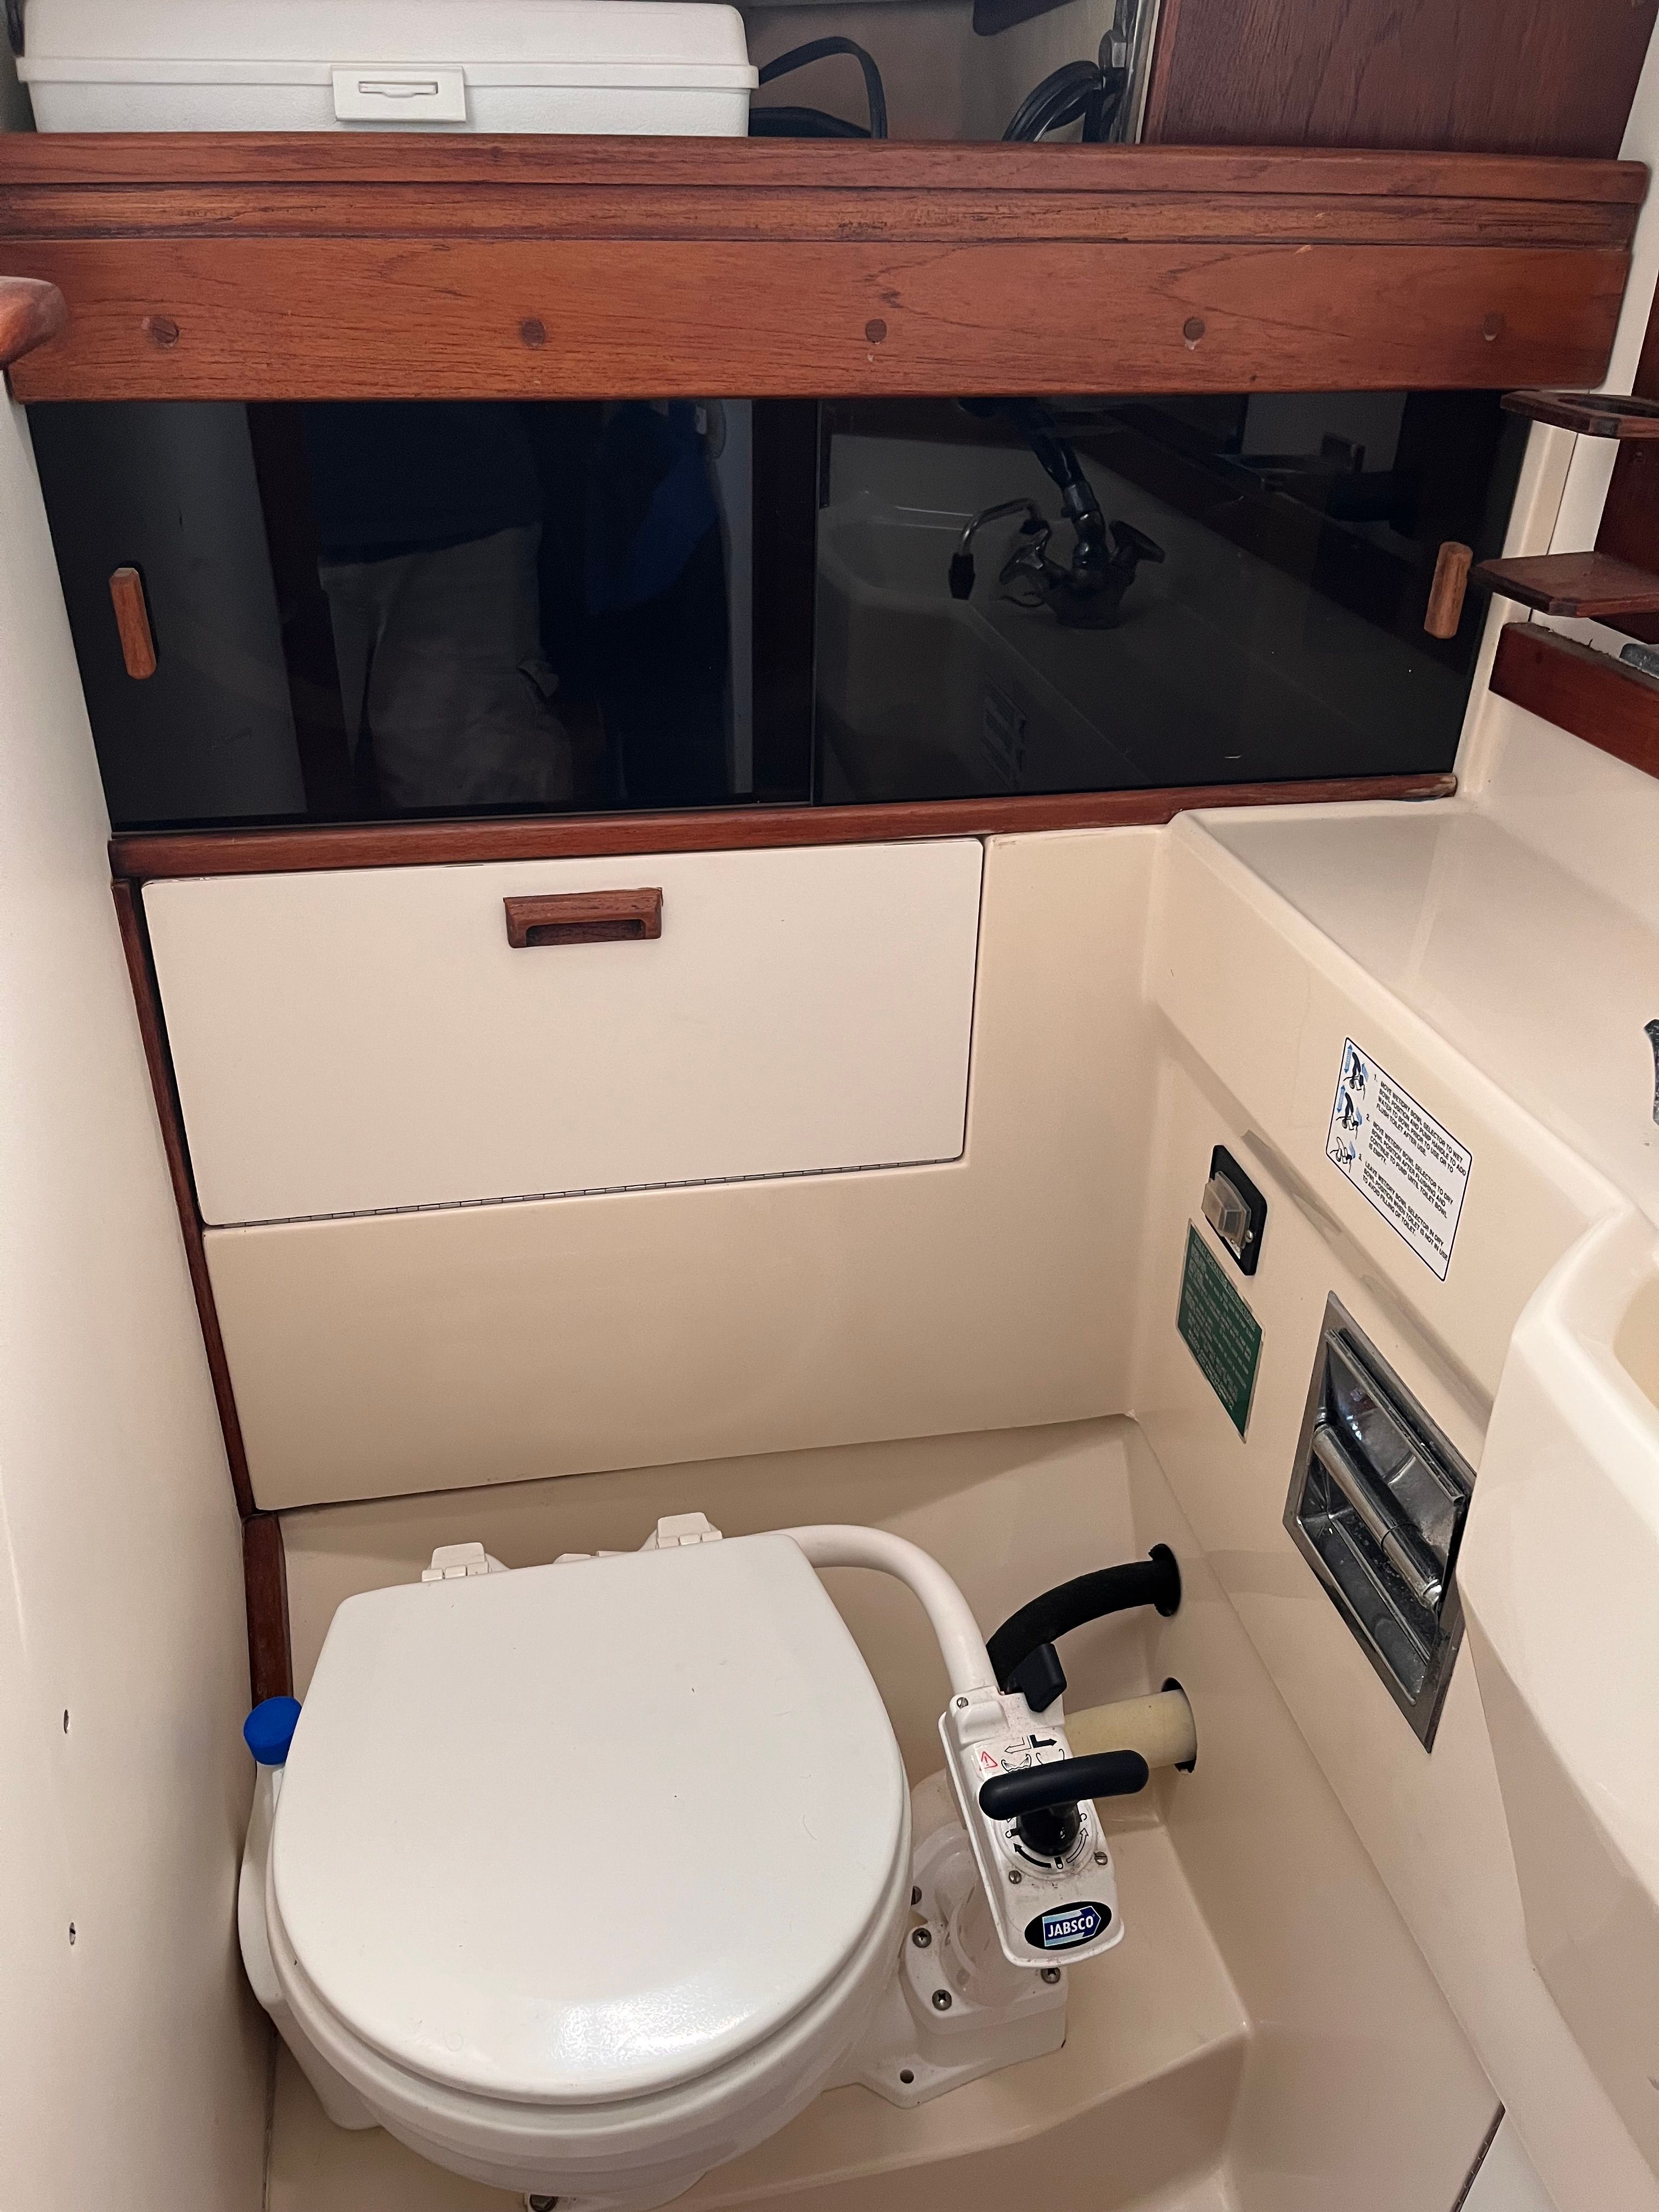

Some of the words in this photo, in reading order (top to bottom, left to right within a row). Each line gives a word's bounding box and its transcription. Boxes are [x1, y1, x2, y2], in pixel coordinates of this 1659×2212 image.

[1373, 1120, 1384, 1136] MOVE
[1402, 1150, 1414, 1167] BOWL
[1414, 1162, 1437, 1189] SELECTOR
[1436, 1185, 1443, 1196] TO
[1443, 1192, 1453, 1206] DRY
[1378, 1095, 1392, 1113] WATER
[1391, 1109, 1398, 1119] TO
[1398, 1115, 1410, 1132] BOWL
[1410, 1127, 1424, 1144] PRIOR
[1423, 1139, 1430, 1151] TO
[1430, 1147, 1440, 1160] USE
[1439, 1155, 1447, 1167] OR
[1446, 1163, 1453, 1174] TO
[1379, 1087, 1391, 1104] BOWL
[1391, 1099, 1410, 1122] POSITION
[1409, 1118, 1419, 1131] AND
[1419, 1126, 1431, 1143] PUMP
[1431, 1138, 1449, 1160] HANDLE
[1448, 1155, 1456, 1167] TO
[1456, 1163, 1466, 1177] ADD
[1380, 1080, 1392, 1096] MOVE
[1410, 1109, 1423, 1126] BOWL
[1423, 1121, 1446, 1148] SELECTOR
[1445, 1143, 1452, 1154] TO
[1452, 1150, 1463, 1164] WET
[1389, 1115, 1403, 1133] TOILET
[1403, 1128, 1417, 1147] AFTER
[1362, 1174, 1368, 1184] TO
[1368, 1180, 1380, 1198] AVOID
[1380, 1193, 1395, 1214] FILLING
[1394, 1209, 1401, 1220] OF
[1364, 1160, 1378, 1177] LEAVE
[1395, 1192, 1407, 1209] BOWL
[1407, 1205, 1429, 1232] SELECTOR
[1429, 1228, 1434, 1238] IN
[1434, 1233, 1443, 1248] DRY
[1369, 1135, 1389, 1159] CONTINUE
[1389, 1154, 1396, 1165] TO
[1395, 1161, 1407, 1177] PUMP
[1407, 1173, 1420, 1190] UNTIL
[1419, 1185, 1434, 1205] TOILET
[1434, 1200, 1448, 1219] BOWL
[1371, 1127, 1383, 1144] BOWL
[1383, 1139, 1402, 1163] POSITION
[1401, 1158, 1415, 1176] AFTER
[1415, 1172, 1436, 1198] FLUSHING
[1436, 1193, 1446, 1207] AND
[1363, 1167, 1375, 1184] BOWL
[1375, 1179, 1393, 1203] POSITION
[1393, 1199, 1406, 1216] WHEN
[1405, 1211, 1420, 1232] TOILET
[1424, 1232, 1434, 1246] NOT
[1434, 1242, 1439, 1251] IN
[1438, 1248, 1448, 1262] USE
[1048, 1915, 1093, 1937] JABSCO
